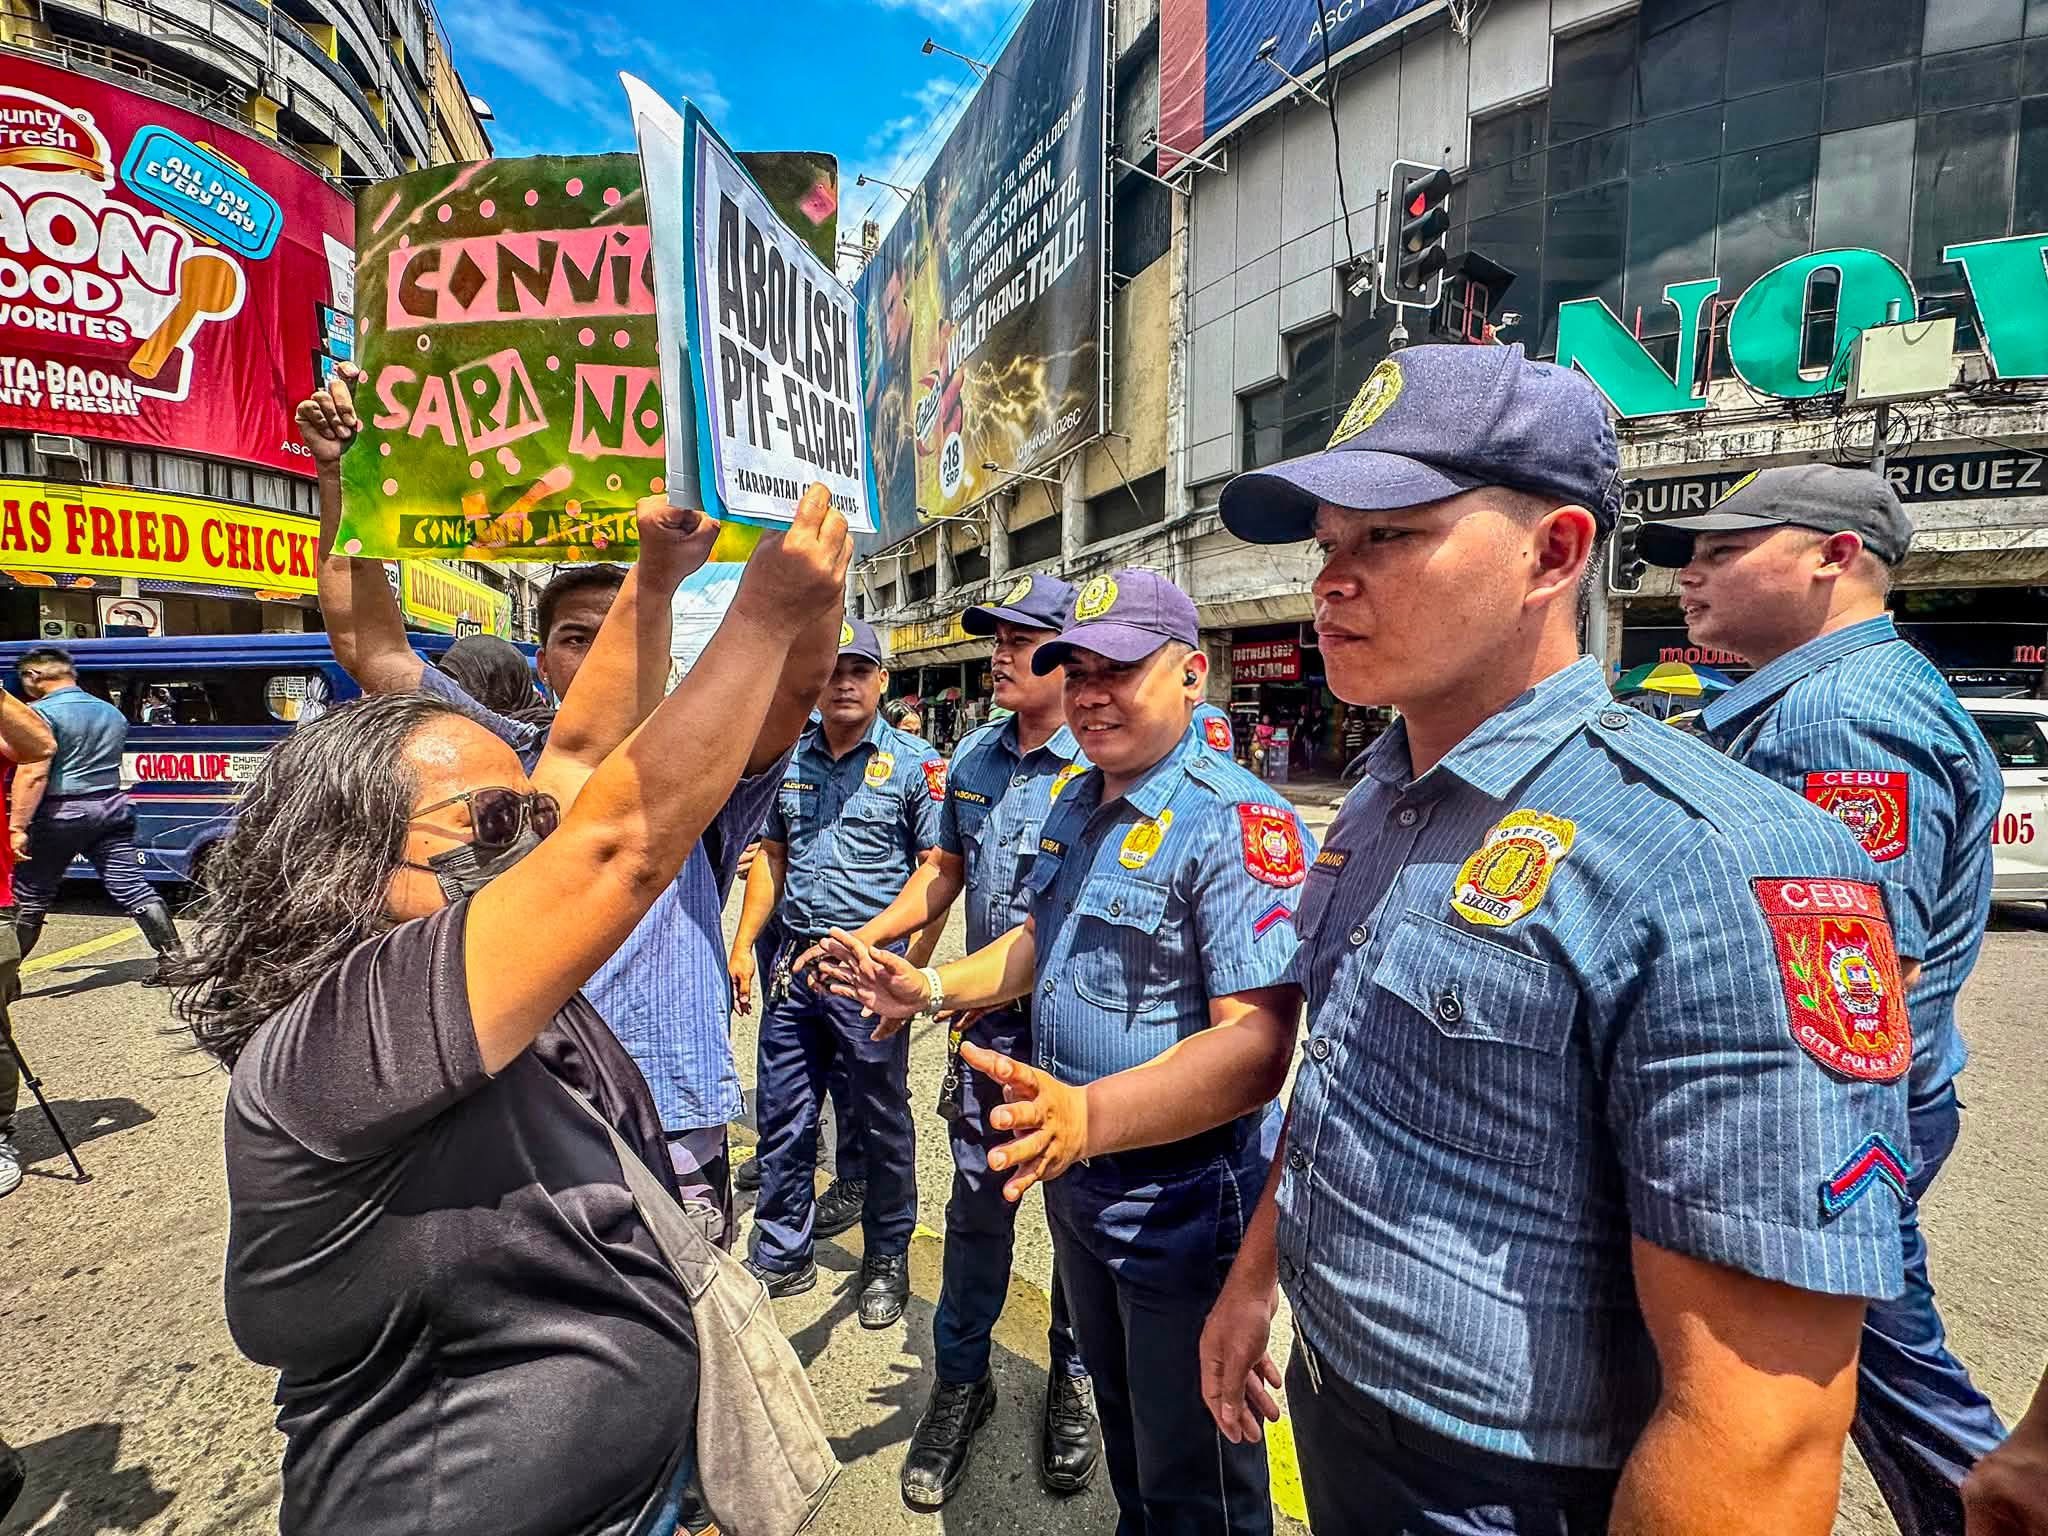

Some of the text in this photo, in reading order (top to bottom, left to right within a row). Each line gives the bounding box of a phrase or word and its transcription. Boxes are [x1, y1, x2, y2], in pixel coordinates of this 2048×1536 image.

[0, 108, 61, 131] unty
[1018, 139, 1044, 180] NASA
[1045, 110, 1070, 153] LOOB
[146, 160, 258, 237] EVERY DAY.
[167, 156, 251, 217] ALL DAY.
[968, 215, 999, 273] PARA
[972, 235, 1013, 301] MERON
[1016, 212, 1039, 258] KA
[719, 190, 851, 405] ABOLISH
[947, 198, 1088, 377] WALA KANG TALO!
[50, 393, 140, 417] FRESH!
[373, 361, 541, 447] SARA
[719, 332, 860, 481] PTF-ELCAC!
[281, 440, 313, 458] ASC
[1, 500, 320, 579] AS FRIED CHICK
[1272, 643, 1295, 659] SHOP
[135, 753, 233, 781] GUADALUPE
[1823, 772, 1889, 785] CEBU
[1250, 805, 1286, 820] CEBU
[1869, 840, 1904, 857] OFFICE
[1780, 882, 1869, 911] CEBU
[1800, 1025, 1886, 1071] CITY POLICE
